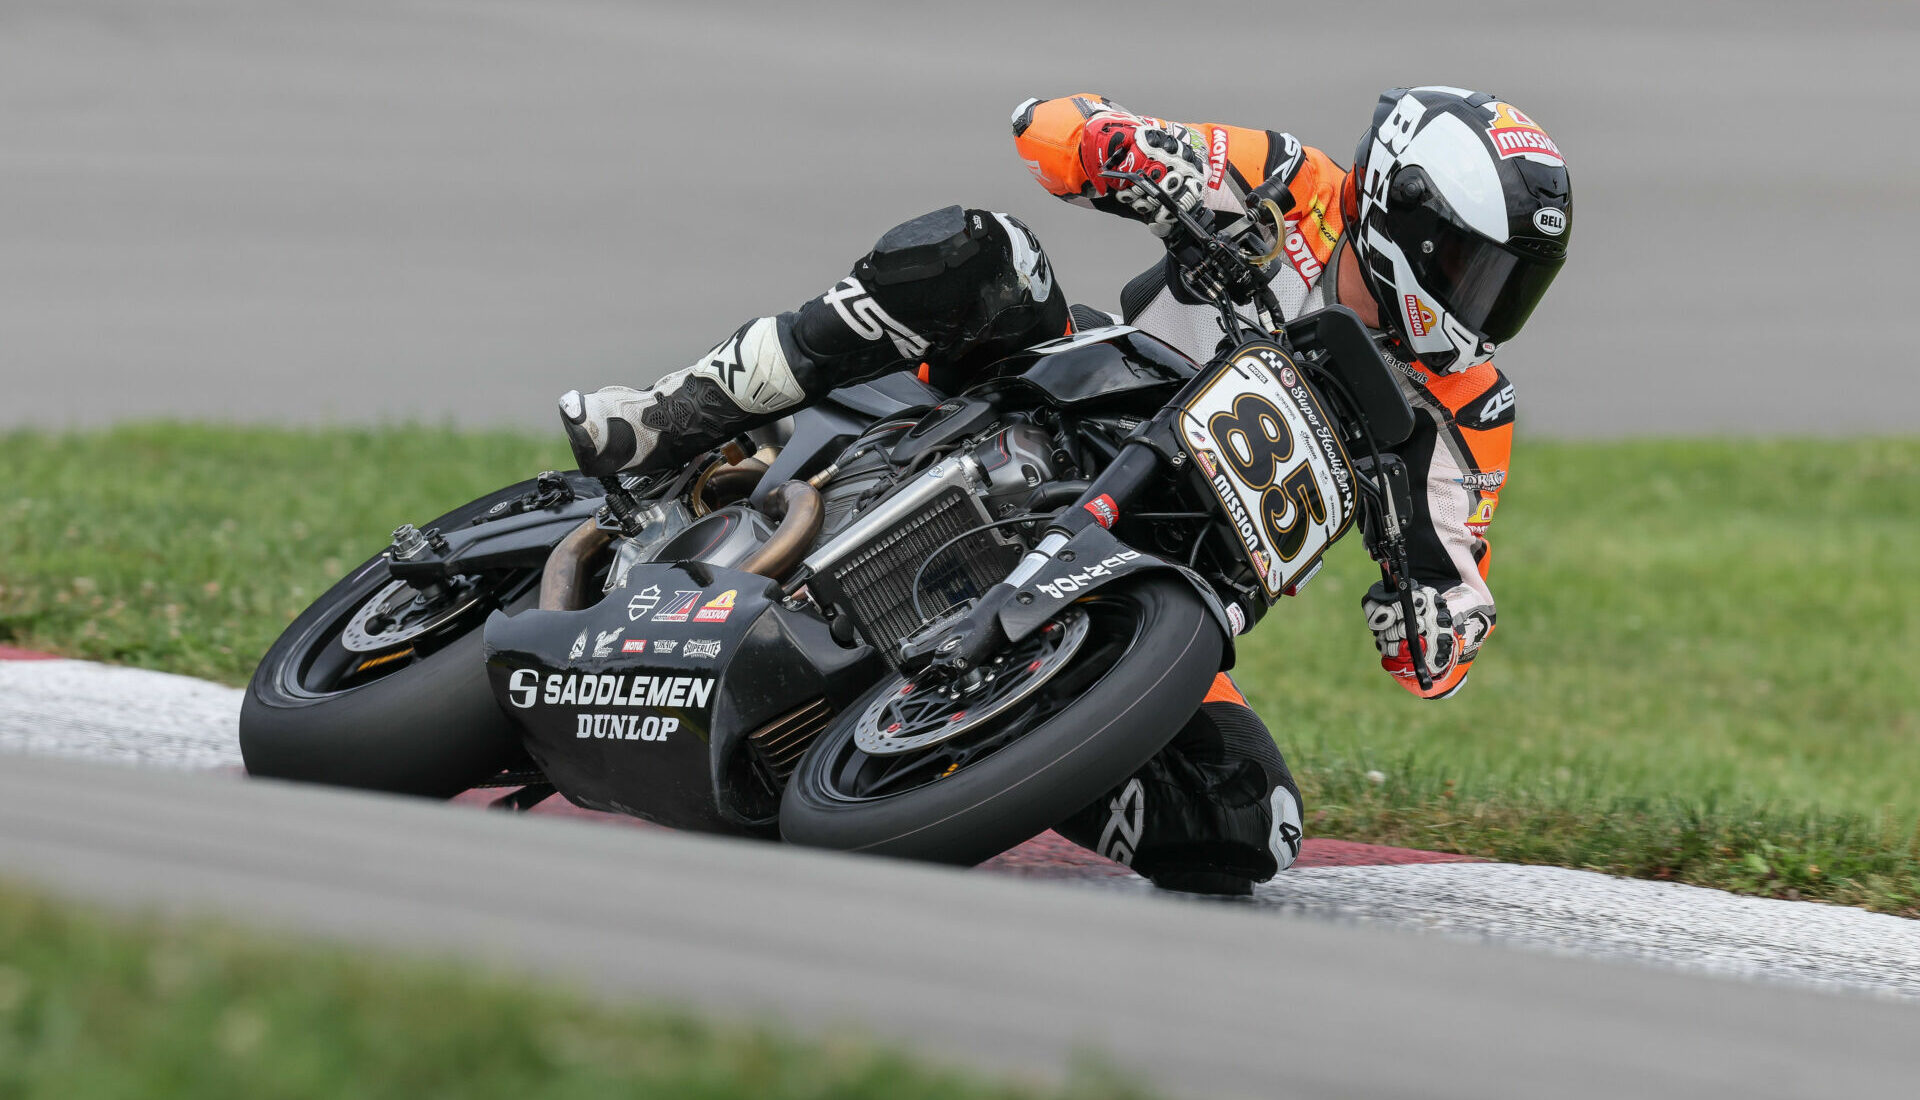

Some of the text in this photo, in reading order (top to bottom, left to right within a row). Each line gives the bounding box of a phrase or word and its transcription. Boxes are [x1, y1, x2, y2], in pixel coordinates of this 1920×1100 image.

[1497, 131, 1561, 155] MISSIO
[1540, 213, 1563, 229] BELL
[1248, 364, 1268, 384] MOTUL
[1291, 386, 1321, 428] Super
[1479, 384, 1516, 423] 4S
[1207, 391, 1328, 563] 85
[1462, 470, 1503, 488] DRAG
[1213, 473, 1260, 552] MISSION
[1035, 549, 1142, 599] DUNLOP
[624, 641, 645, 651] MOTUL
[684, 641, 720, 656] SUPERLITE
[544, 674, 716, 708] SADDLEMEN
[576, 714, 680, 742] DUNLOP
